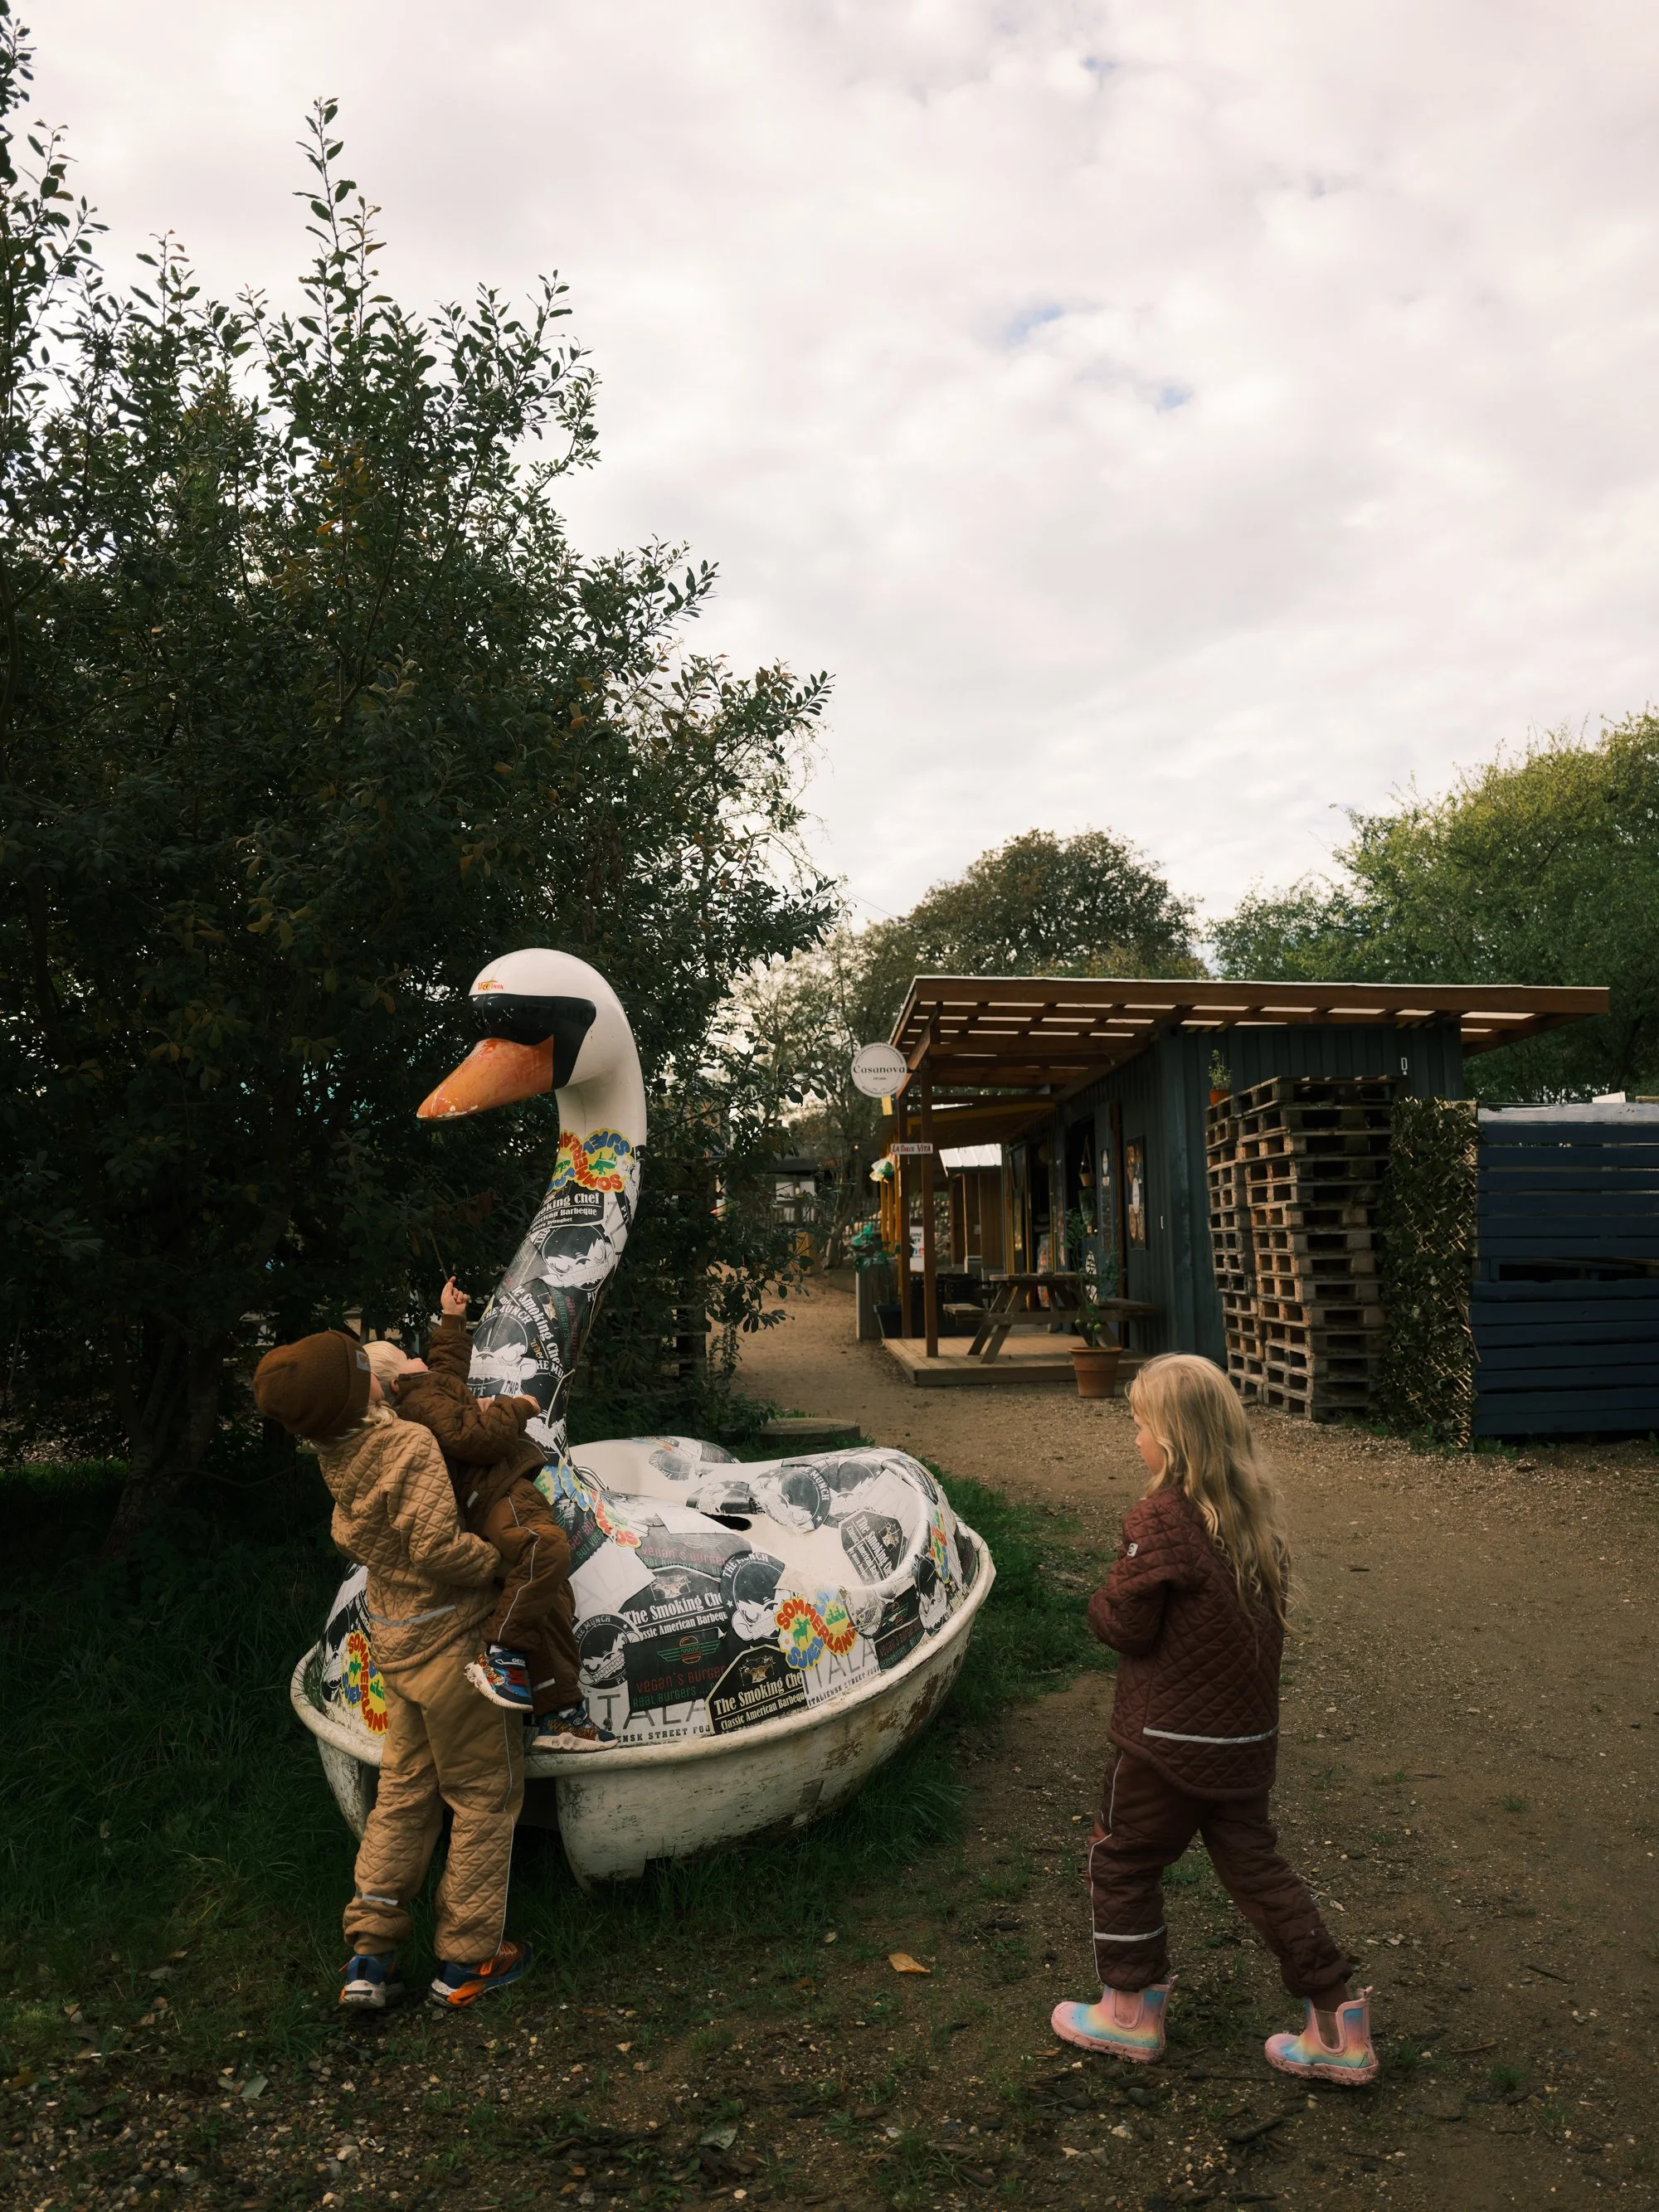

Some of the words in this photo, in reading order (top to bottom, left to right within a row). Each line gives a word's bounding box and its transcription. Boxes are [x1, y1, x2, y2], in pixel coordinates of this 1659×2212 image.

[853, 1065, 906, 1074] Casanova
[892, 1145, 900, 1153] LA
[917, 1144, 931, 1153] VITA
[574, 1192, 600, 1204] Chef
[560, 1208, 598, 1216] Barbeque
[518, 1293, 555, 1342] Smoking
[624, 1609, 649, 1626] The
[649, 1594, 704, 1621] Smoking
[584, 1615, 611, 1631] MUNCH
[659, 1616, 695, 1636] American
[714, 1697, 737, 1715] The
[737, 1677, 785, 1708] Smoking
[808, 1685, 843, 1707] ITALIENSK
[844, 1673, 865, 1689] STREET
[720, 1714, 745, 1732] Classic
[746, 1703, 778, 1722] American
[648, 1728, 689, 1741] STREET
